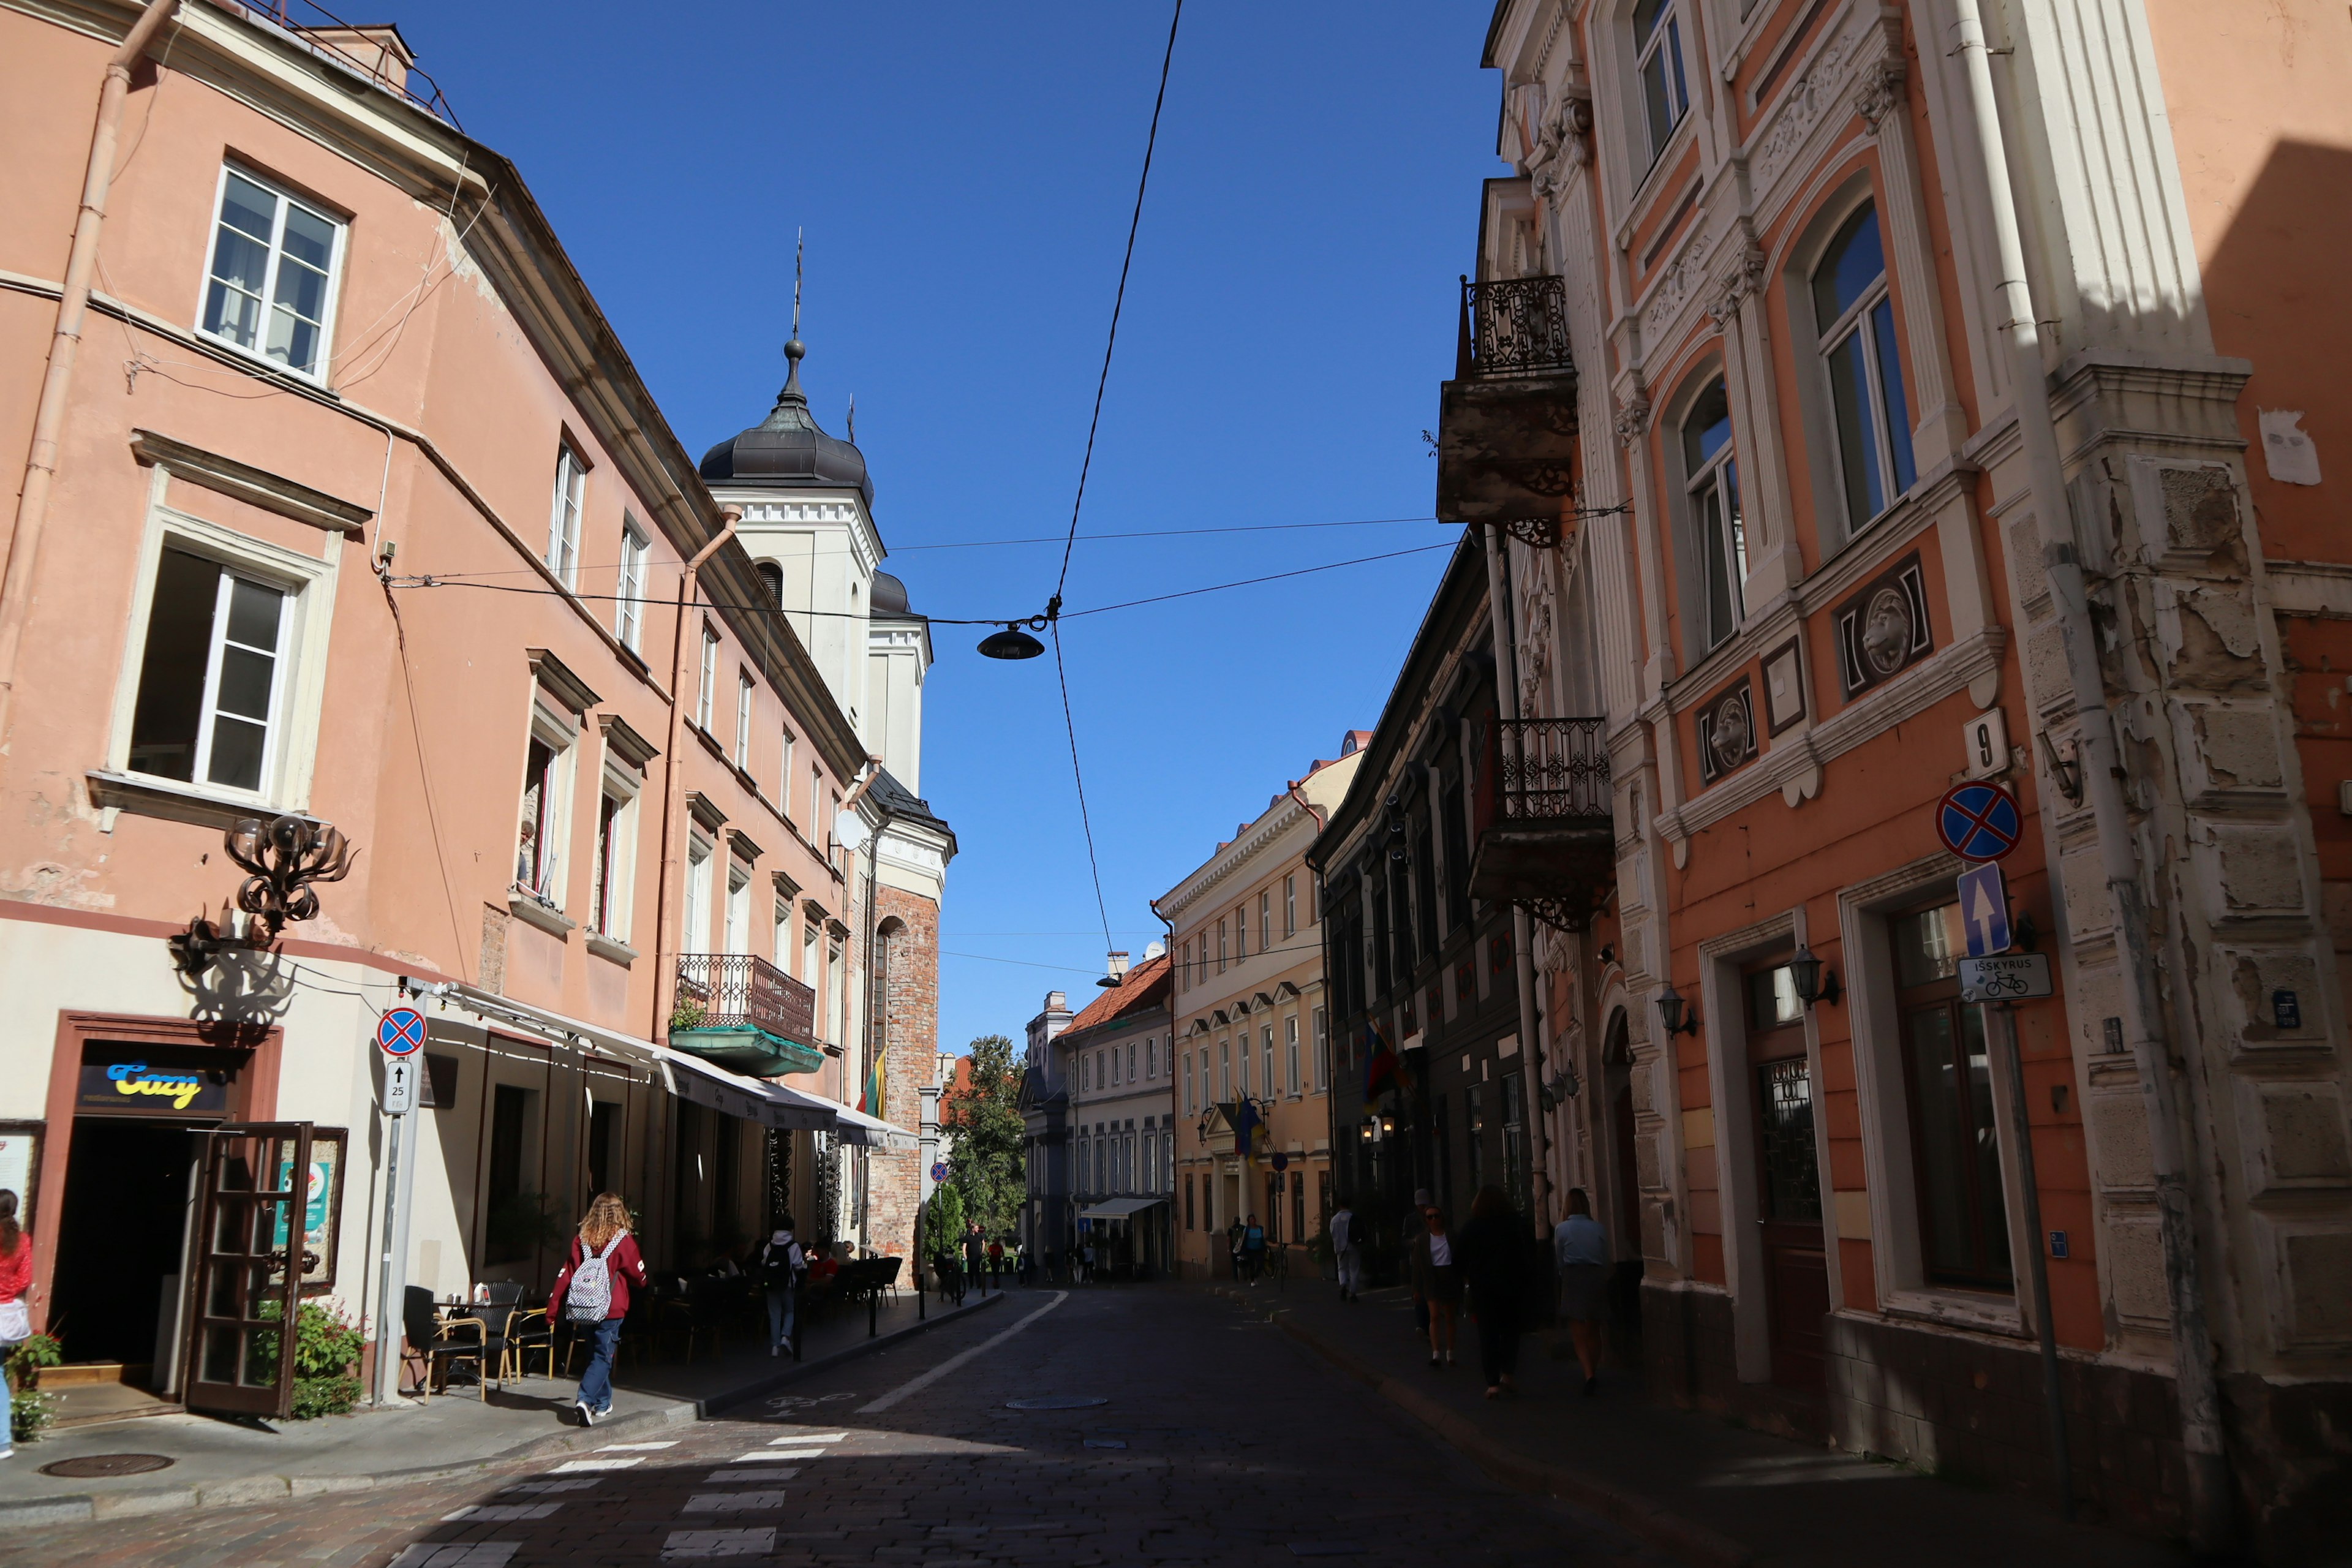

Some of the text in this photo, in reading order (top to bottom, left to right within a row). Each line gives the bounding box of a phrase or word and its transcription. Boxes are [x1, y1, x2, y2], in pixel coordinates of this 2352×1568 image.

[1977, 723, 1993, 768] 9
[1975, 959, 2032, 971] IŠSKYRUS
[107, 1060, 202, 1110] Cozy
[392, 1087, 404, 1096] 25
